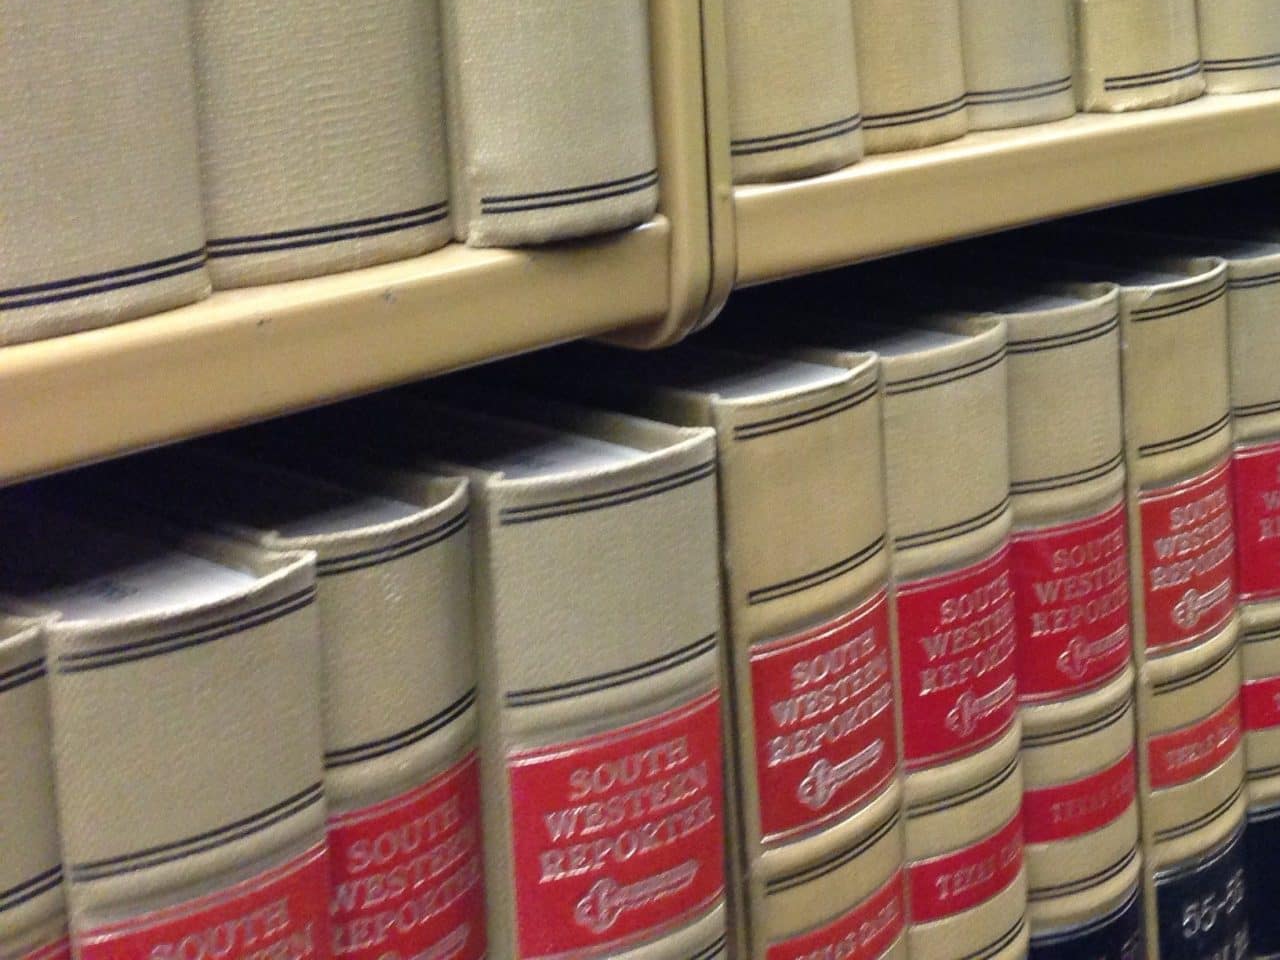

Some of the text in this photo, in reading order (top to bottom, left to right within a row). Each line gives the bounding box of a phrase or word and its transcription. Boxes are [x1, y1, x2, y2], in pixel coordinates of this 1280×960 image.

[543, 759, 709, 843] WESTERN
[568, 735, 689, 802] SOUTH
[538, 795, 717, 885] REPORTER
